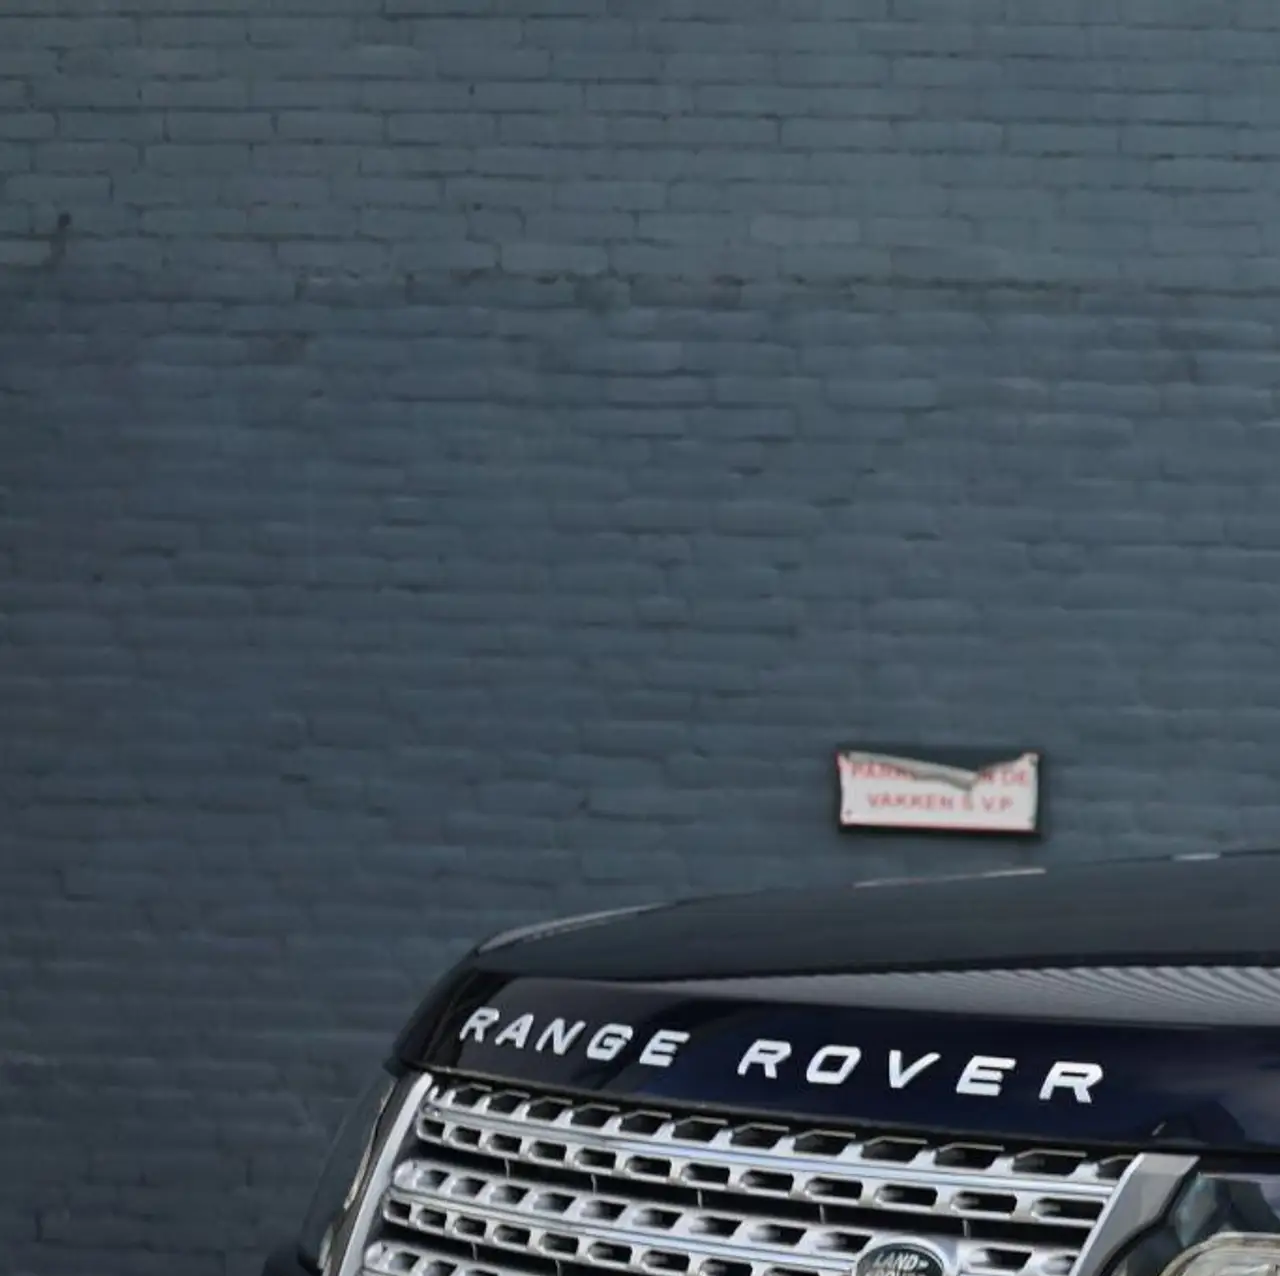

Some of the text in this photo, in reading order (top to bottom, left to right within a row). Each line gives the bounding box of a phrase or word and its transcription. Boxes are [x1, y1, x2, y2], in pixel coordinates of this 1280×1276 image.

[459, 1007, 1103, 1102] RANGE ROVER
[872, 1252, 919, 1271] LAND
